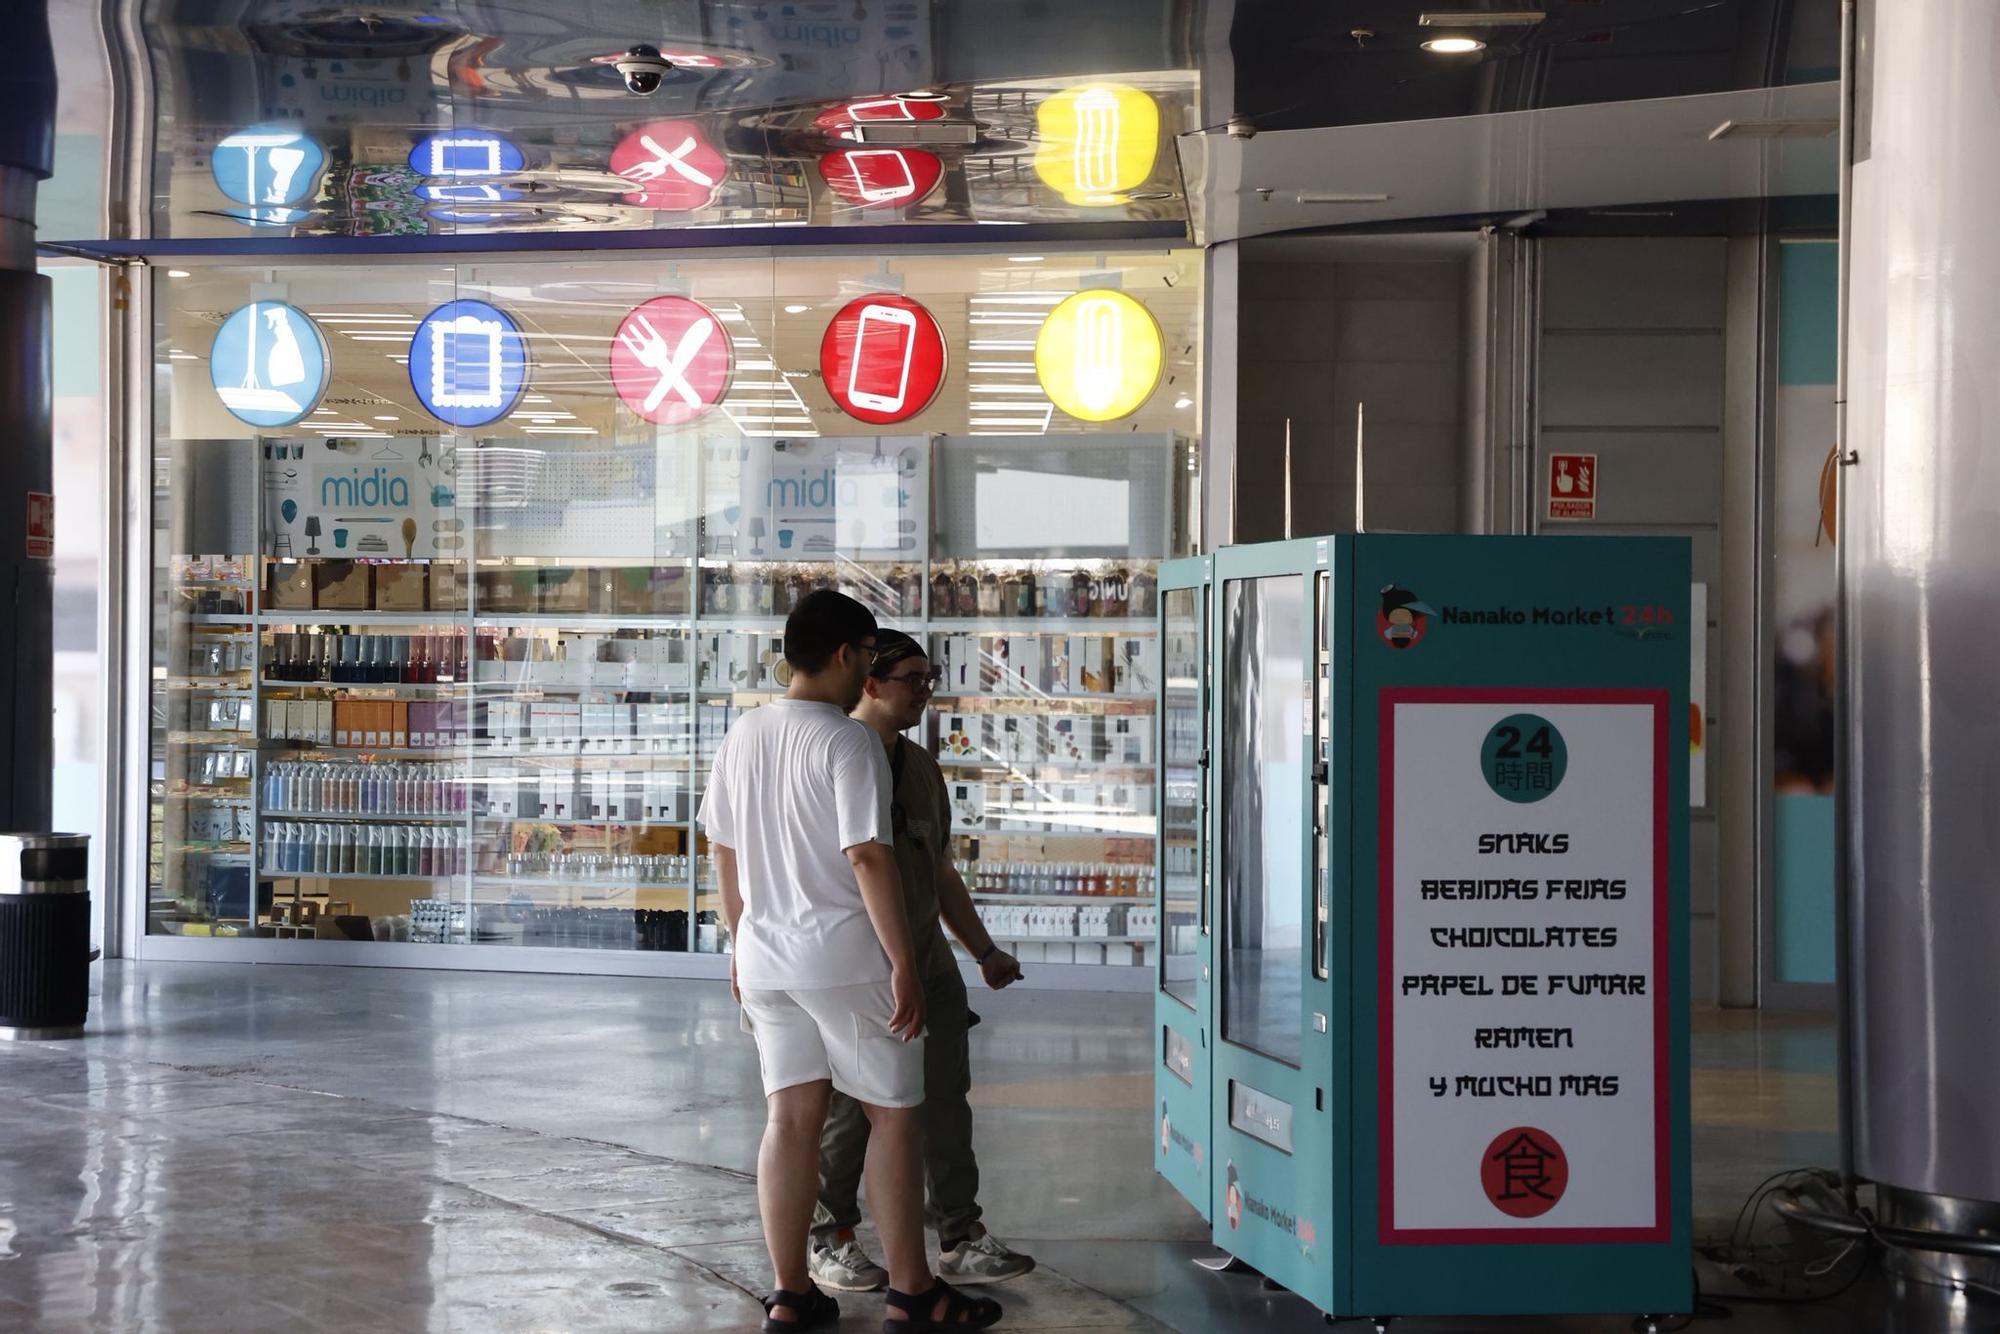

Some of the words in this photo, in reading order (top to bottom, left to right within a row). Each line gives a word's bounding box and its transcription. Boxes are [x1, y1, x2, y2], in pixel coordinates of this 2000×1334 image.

[322, 467, 409, 507] midia
[1442, 606, 1526, 625] Nanako
[1532, 606, 1615, 625] Market
[1620, 604, 1674, 625] 24h
[1495, 725, 1553, 758] 24
[1495, 760, 1553, 791] 時間
[1478, 832, 1570, 854] SNAKS
[1546, 878, 1627, 900] FRIAS
[1402, 974, 1494, 996] PAPEL
[1501, 975, 1539, 996] DE
[1548, 973, 1647, 996] FUMAR
[1474, 1026, 1574, 1049] RAMEN
[1455, 1074, 1552, 1097] MUCHO
[1559, 1074, 1620, 1097] MAS
[1492, 1132, 1557, 1202] 食
[1270, 1205, 1297, 1236] Market
